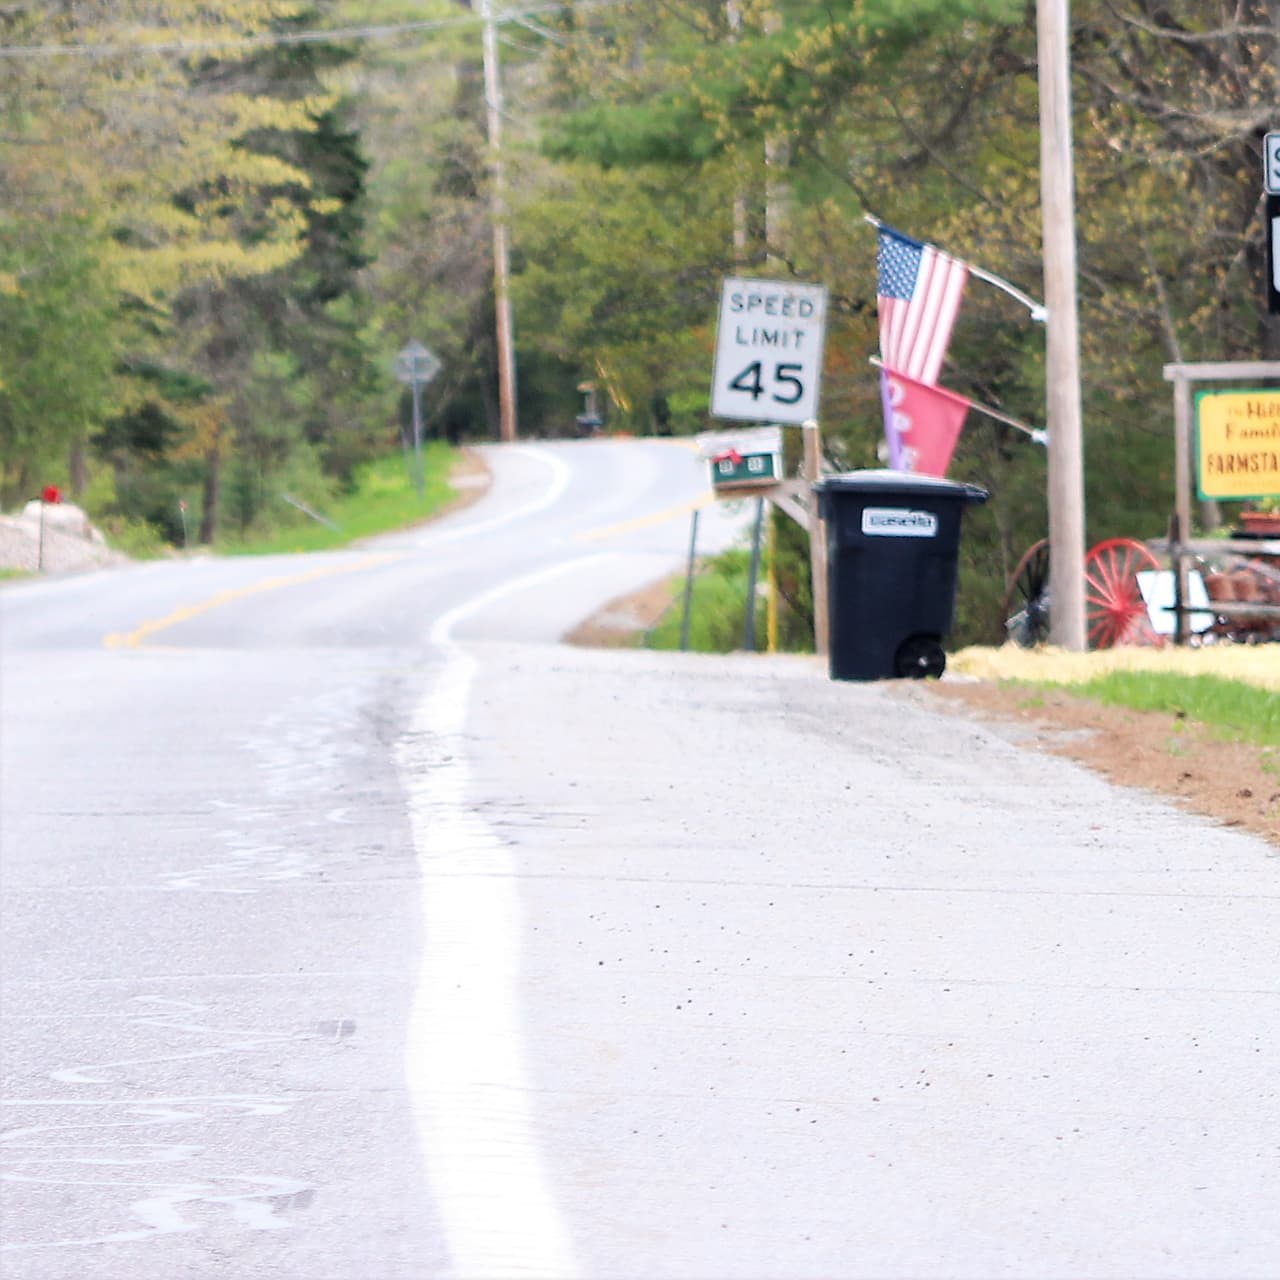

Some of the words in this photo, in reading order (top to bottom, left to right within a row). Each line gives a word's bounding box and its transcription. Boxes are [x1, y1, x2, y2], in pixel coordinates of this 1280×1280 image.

[729, 292, 814, 319] SPEED
[736, 327, 806, 350] LIMIT
[728, 360, 804, 405] 45
